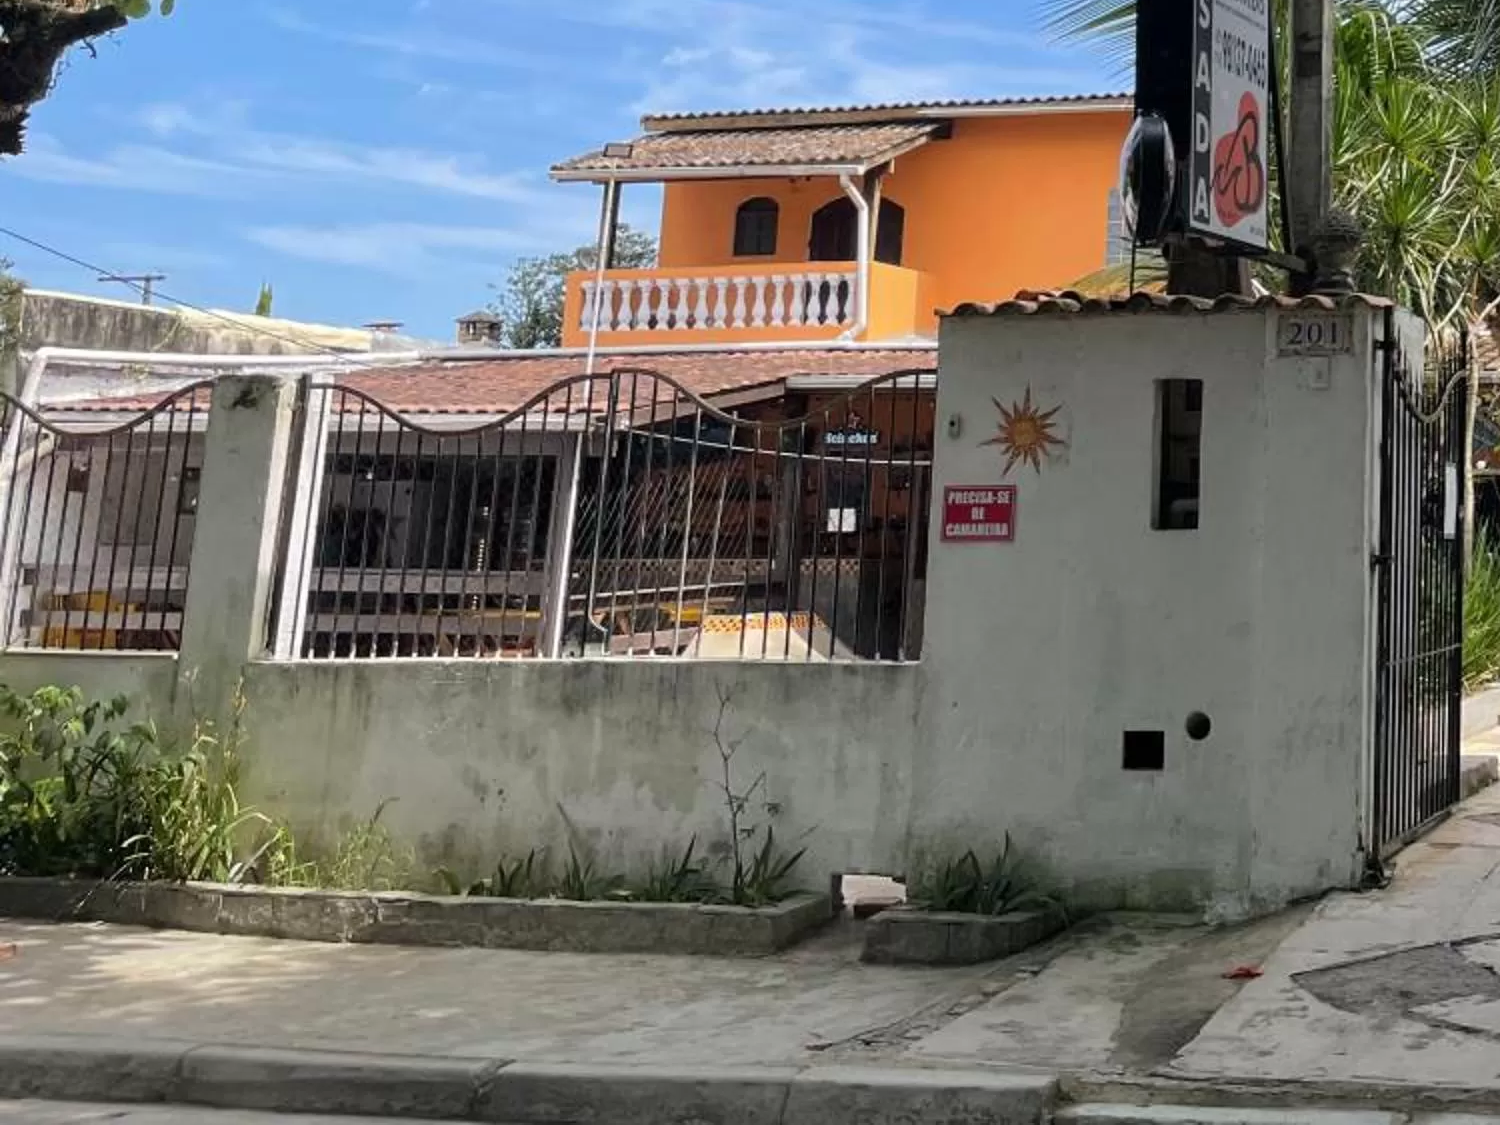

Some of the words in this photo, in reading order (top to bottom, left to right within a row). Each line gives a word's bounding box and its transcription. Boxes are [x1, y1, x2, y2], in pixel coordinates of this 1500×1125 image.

[1287, 321, 1337, 345] 201
[947, 490, 1010, 504] PRECISA-SE
[945, 522, 1009, 536] CAMAREIRA
